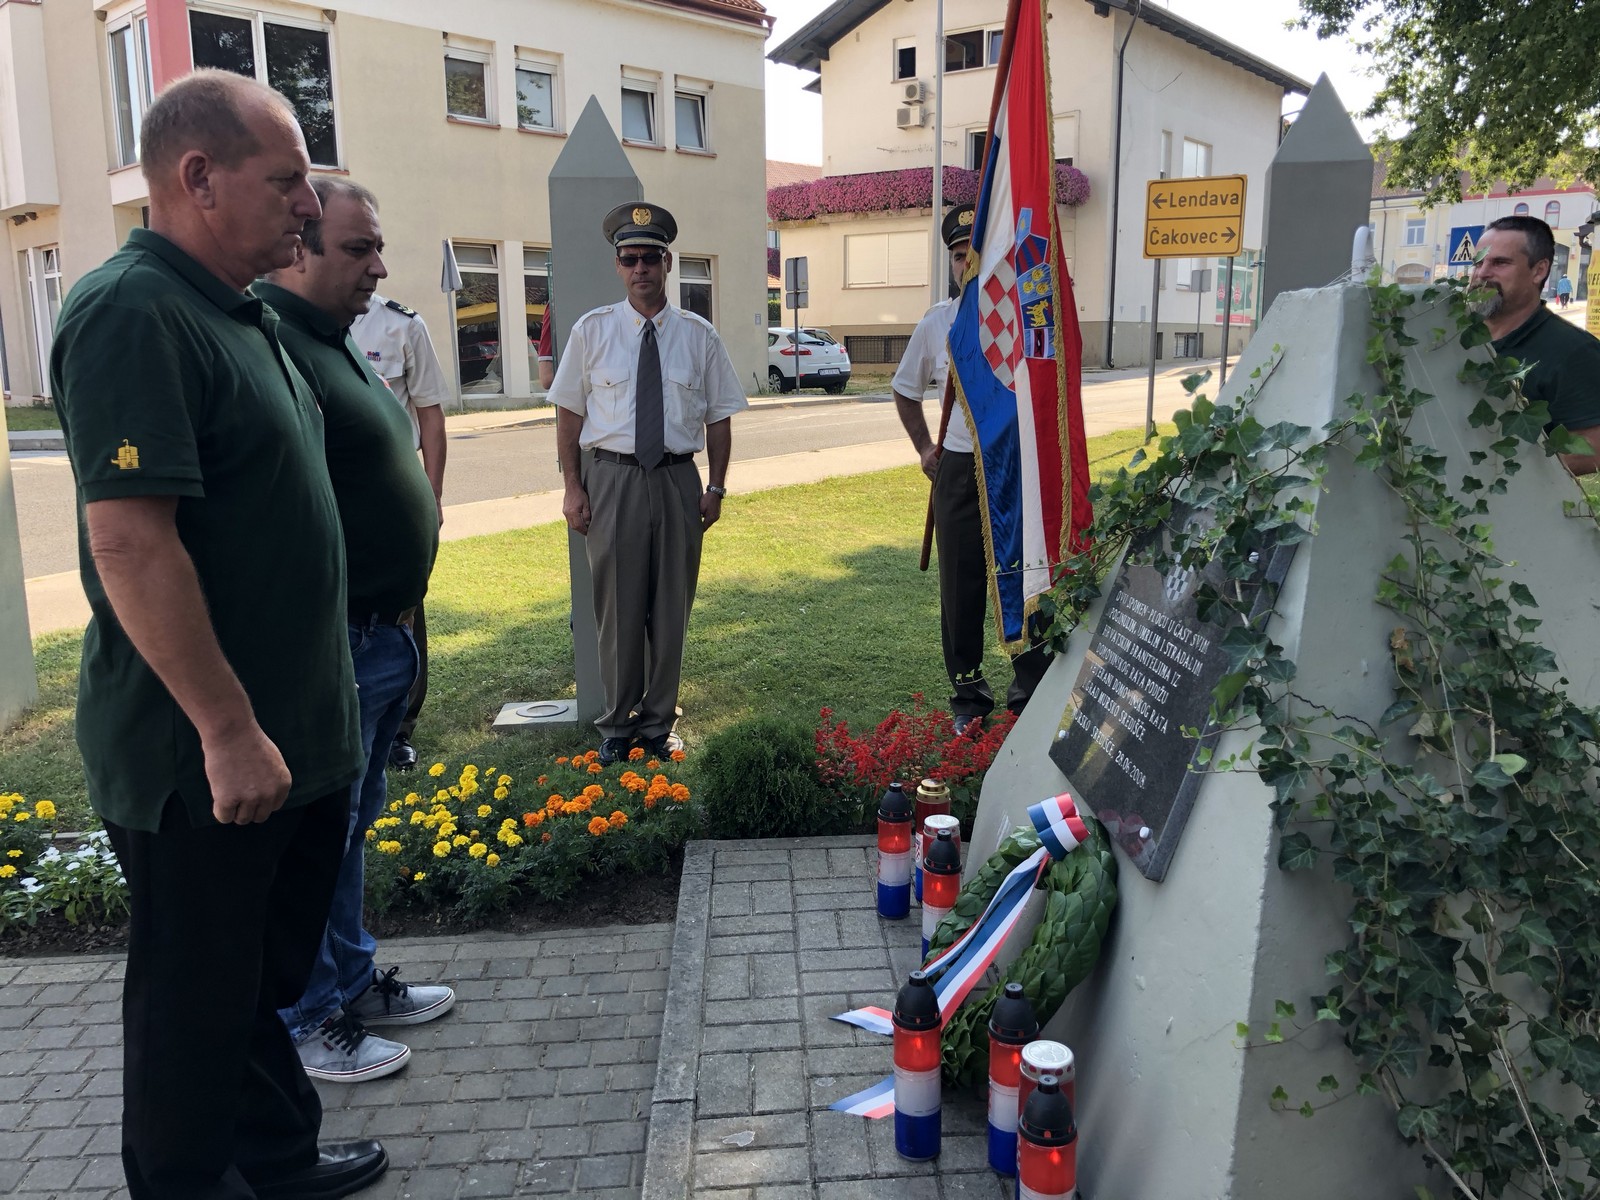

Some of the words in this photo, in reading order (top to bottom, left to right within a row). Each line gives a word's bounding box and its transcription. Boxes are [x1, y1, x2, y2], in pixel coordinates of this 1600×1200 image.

[1169, 190, 1239, 208] Lendava
[1149, 226, 1218, 245] Čakovec
[1137, 624, 1162, 649] UMRLIM
[1159, 638, 1166, 652] I
[1163, 641, 1204, 677] STRADALIM
[1167, 619, 1176, 633] U
[1189, 633, 1211, 655] SVIM
[1101, 624, 1132, 653] HRVATSKIM
[1129, 643, 1171, 682] BRANITELJIMA
[1170, 671, 1182, 688] IZ
[1085, 680, 1100, 699] GRAD
[1097, 691, 1120, 717] MURSKO
[1128, 666, 1146, 689] RATA
[1144, 678, 1170, 705] PODIŽU
[1148, 709, 1169, 734] RATA
